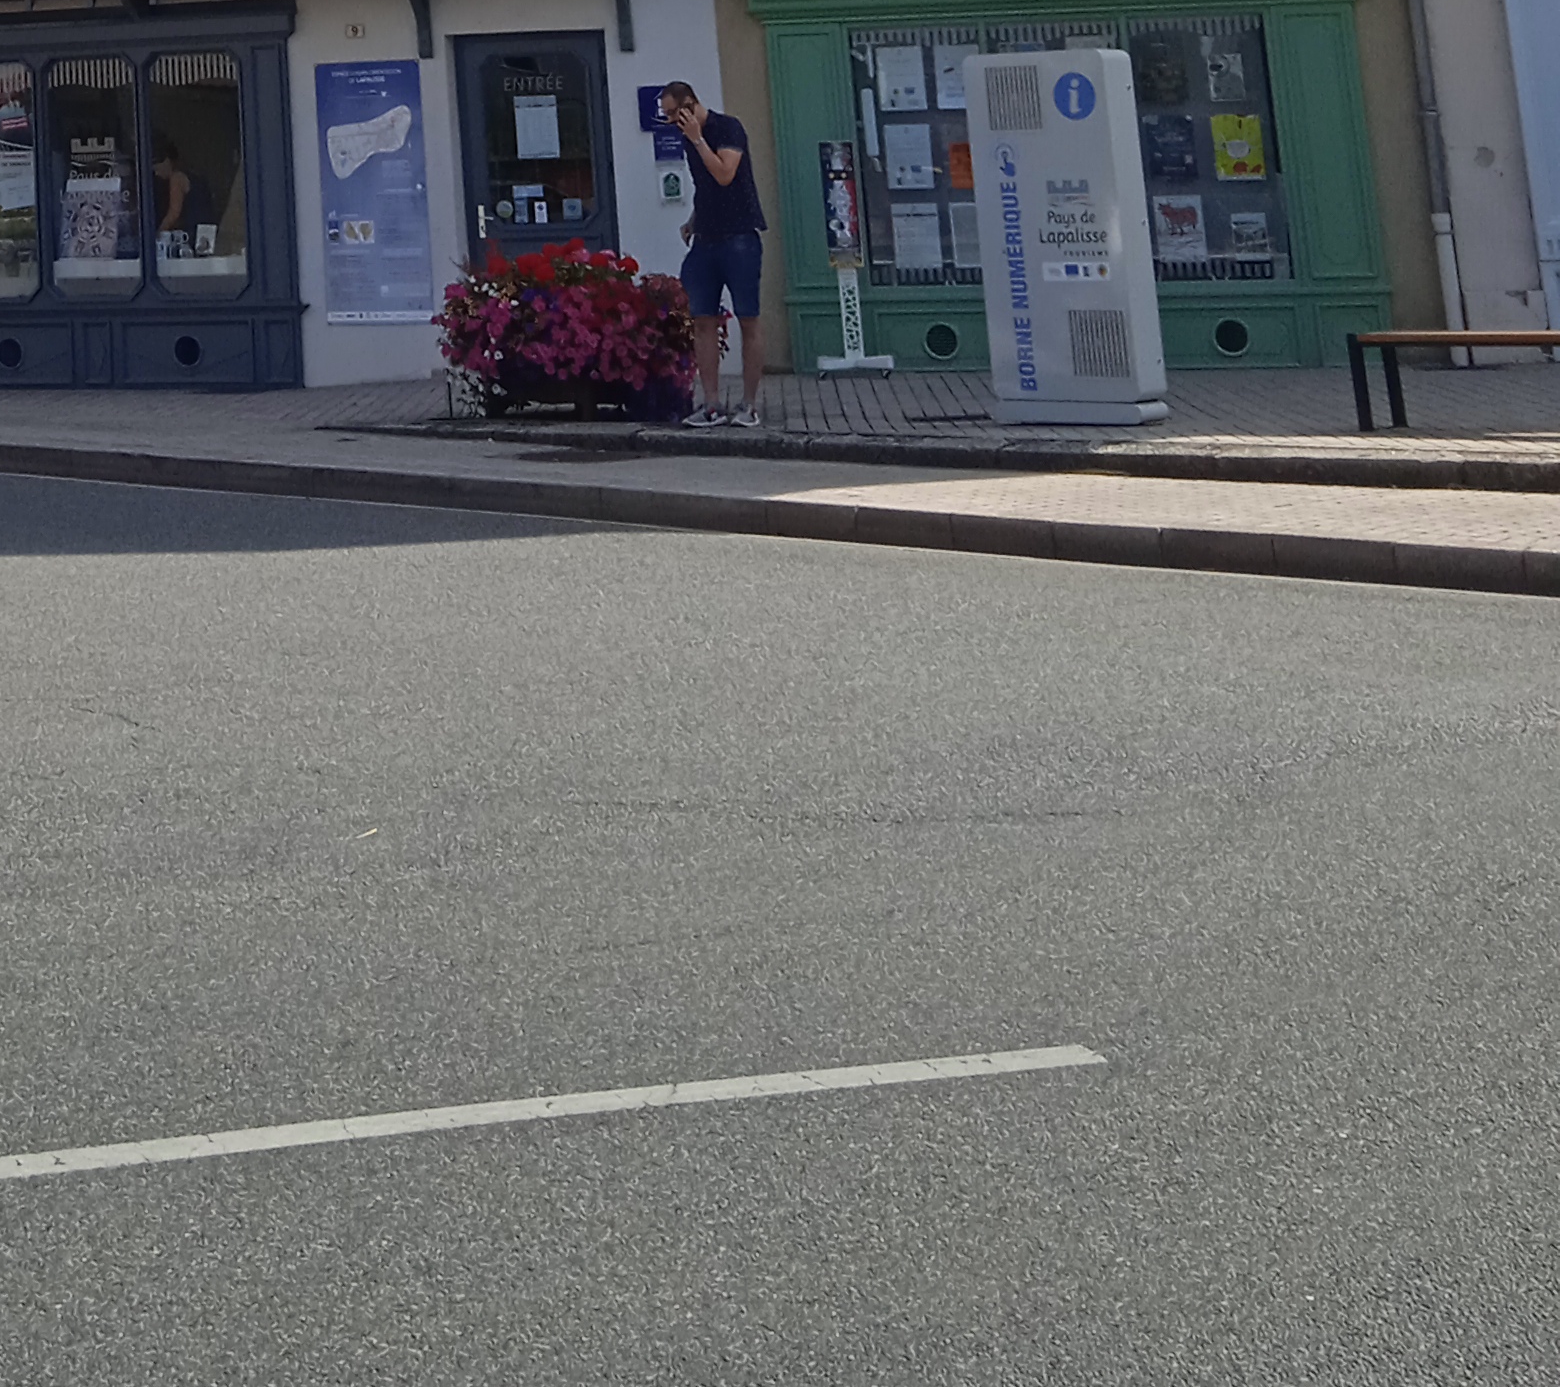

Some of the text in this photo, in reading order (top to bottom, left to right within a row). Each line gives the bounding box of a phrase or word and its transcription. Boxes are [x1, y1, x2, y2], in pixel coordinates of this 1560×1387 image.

[351, 25, 359, 37] 9
[503, 72, 564, 92] ENTRÉE
[1048, 210, 1096, 228] Pays de
[1039, 229, 1108, 249] Lapalisse
[1001, 181, 1038, 391] BORNE NUMÉRIQUE
